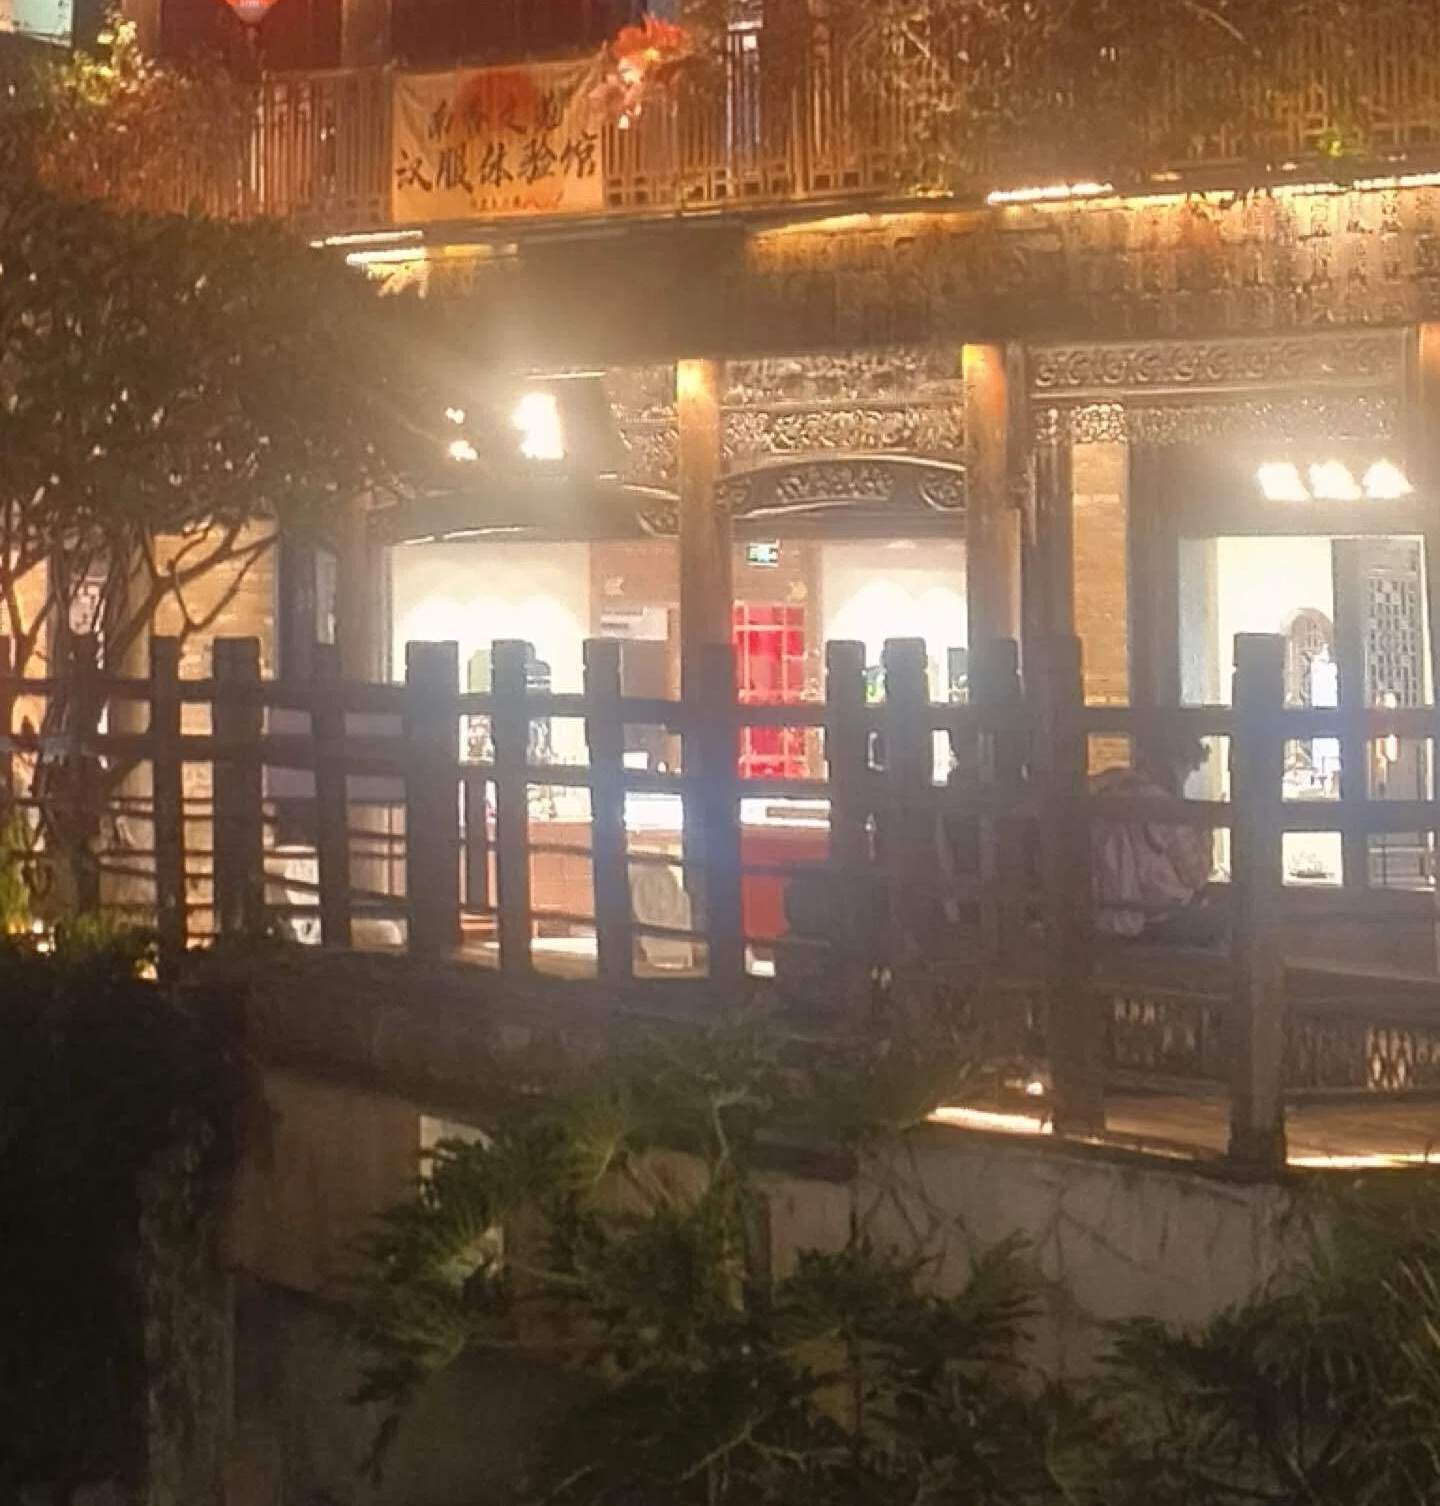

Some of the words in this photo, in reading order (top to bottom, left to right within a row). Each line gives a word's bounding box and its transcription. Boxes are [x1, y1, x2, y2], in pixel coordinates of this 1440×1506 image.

[396, 130, 597, 193] 汉服体验馆
